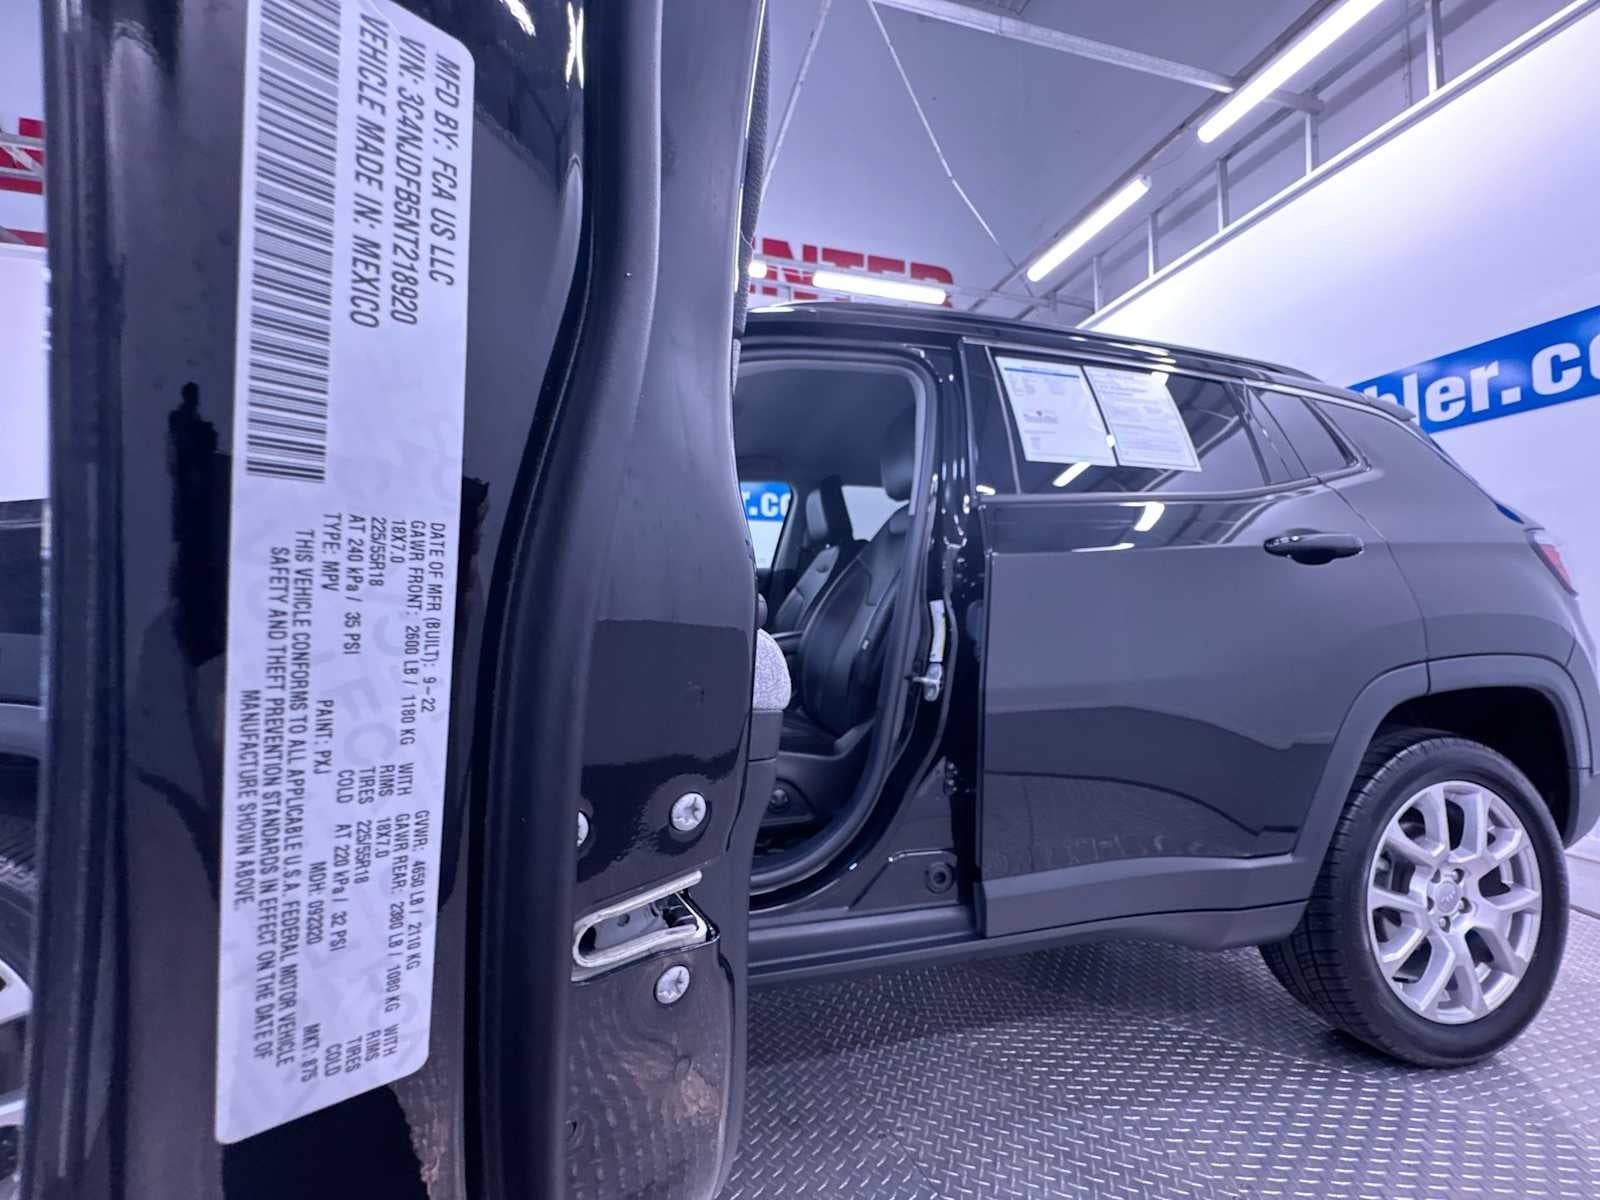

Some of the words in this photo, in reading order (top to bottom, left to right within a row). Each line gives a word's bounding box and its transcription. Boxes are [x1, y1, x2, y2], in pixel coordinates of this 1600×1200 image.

[356, 13, 390, 117] VEHICLE
[398, 35, 427, 85] VIN:
[434, 53, 461, 109] MFD
[433, 109, 459, 151] BY:
[354, 115, 386, 192] MADE
[431, 156, 458, 202] FCA
[353, 192, 383, 230] IN:
[389, 85, 425, 326] 3C4NJDFB5NT218920
[429, 207, 457, 242] US
[349, 234, 382, 329] MEXICO
[428, 243, 455, 287] LLC
[1362, 332, 1600, 427] ler.c
[321, 512, 343, 555] TYPE:
[348, 513, 367, 534] AT
[389, 519, 407, 564] 18X7.0
[408, 520, 427, 562] GAWR
[428, 522, 447, 558] DATE
[294, 529, 316, 563] THIS
[346, 537, 365, 563] 240
[367, 516, 388, 587] 225/55R18
[268, 546, 291, 604] SAFETY
[320, 560, 341, 592] MPV
[345, 566, 365, 592] kPa
[427, 561, 445, 580] OF
[291, 567, 314, 627] VEHICLE
[406, 566, 425, 616] FRONT:
[425, 583, 443, 612] MFR
[267, 608, 289, 641] AND
[343, 611, 362, 629] 35
[343, 632, 362, 655] PSI
[403, 625, 421, 655] 2600
[419, 617, 442, 667] (BUILT):
[265, 644, 288, 691] THEFT
[288, 632, 311, 711] CONFORMS
[403, 659, 420, 676] LB
[287, 714, 309, 735] TO
[314, 699, 335, 745] PAINT:
[400, 694, 417, 724] 1180
[237, 689, 262, 799] MANUFACTURE
[262, 697, 286, 787] PREVENTION
[286, 739, 307, 765] ALL
[399, 727, 416, 746] KG
[312, 749, 333, 775] PXJ
[396, 762, 415, 797] WITH
[335, 769, 356, 804] COLD
[357, 766, 377, 805] TIRES
[377, 764, 396, 798] RIMS
[283, 768, 306, 852] APPLICABLE
[235, 801, 258, 857] SHOWN
[259, 790, 283, 876] STANDARDS
[334, 824, 352, 839] AT
[374, 816, 392, 859] 18X7.0
[392, 812, 410, 853] GAWR
[411, 809, 431, 852] GVWR:
[332, 844, 351, 868] 220
[353, 819, 373, 885] 225/55R18
[233, 859, 257, 911] ABOVE.
[259, 878, 279, 895] IN
[282, 854, 303, 897] U.S.A.
[308, 860, 328, 897] MDH:
[331, 869, 350, 895] kPa
[391, 854, 409, 894] REAR:
[409, 860, 426, 889] 4650
[388, 900, 405, 931] 2380
[408, 890, 425, 907] LB
[256, 896, 279, 947] EFFECT
[279, 899, 301, 963] FEDERAL
[305, 899, 325, 946] 092320
[330, 910, 348, 929] 32
[406, 921, 423, 951] 2110
[329, 929, 348, 952] PSI
[387, 932, 405, 949] LB
[256, 950, 276, 972] ON
[385, 964, 402, 993] 1080
[405, 952, 422, 971] KG
[255, 971, 277, 1002] THE
[277, 963, 299, 1012] MOTOR
[384, 994, 401, 1013] KG
[253, 1002, 276, 1041] DATE
[275, 1011, 297, 1068] VEHICLE
[253, 1040, 274, 1060] OF
[302, 1022, 321, 1058] MKT:
[344, 1035, 363, 1074] TIRES
[364, 1029, 382, 1063] RIMS
[382, 1023, 400, 1058] WITH
[323, 1043, 343, 1078] COLD
